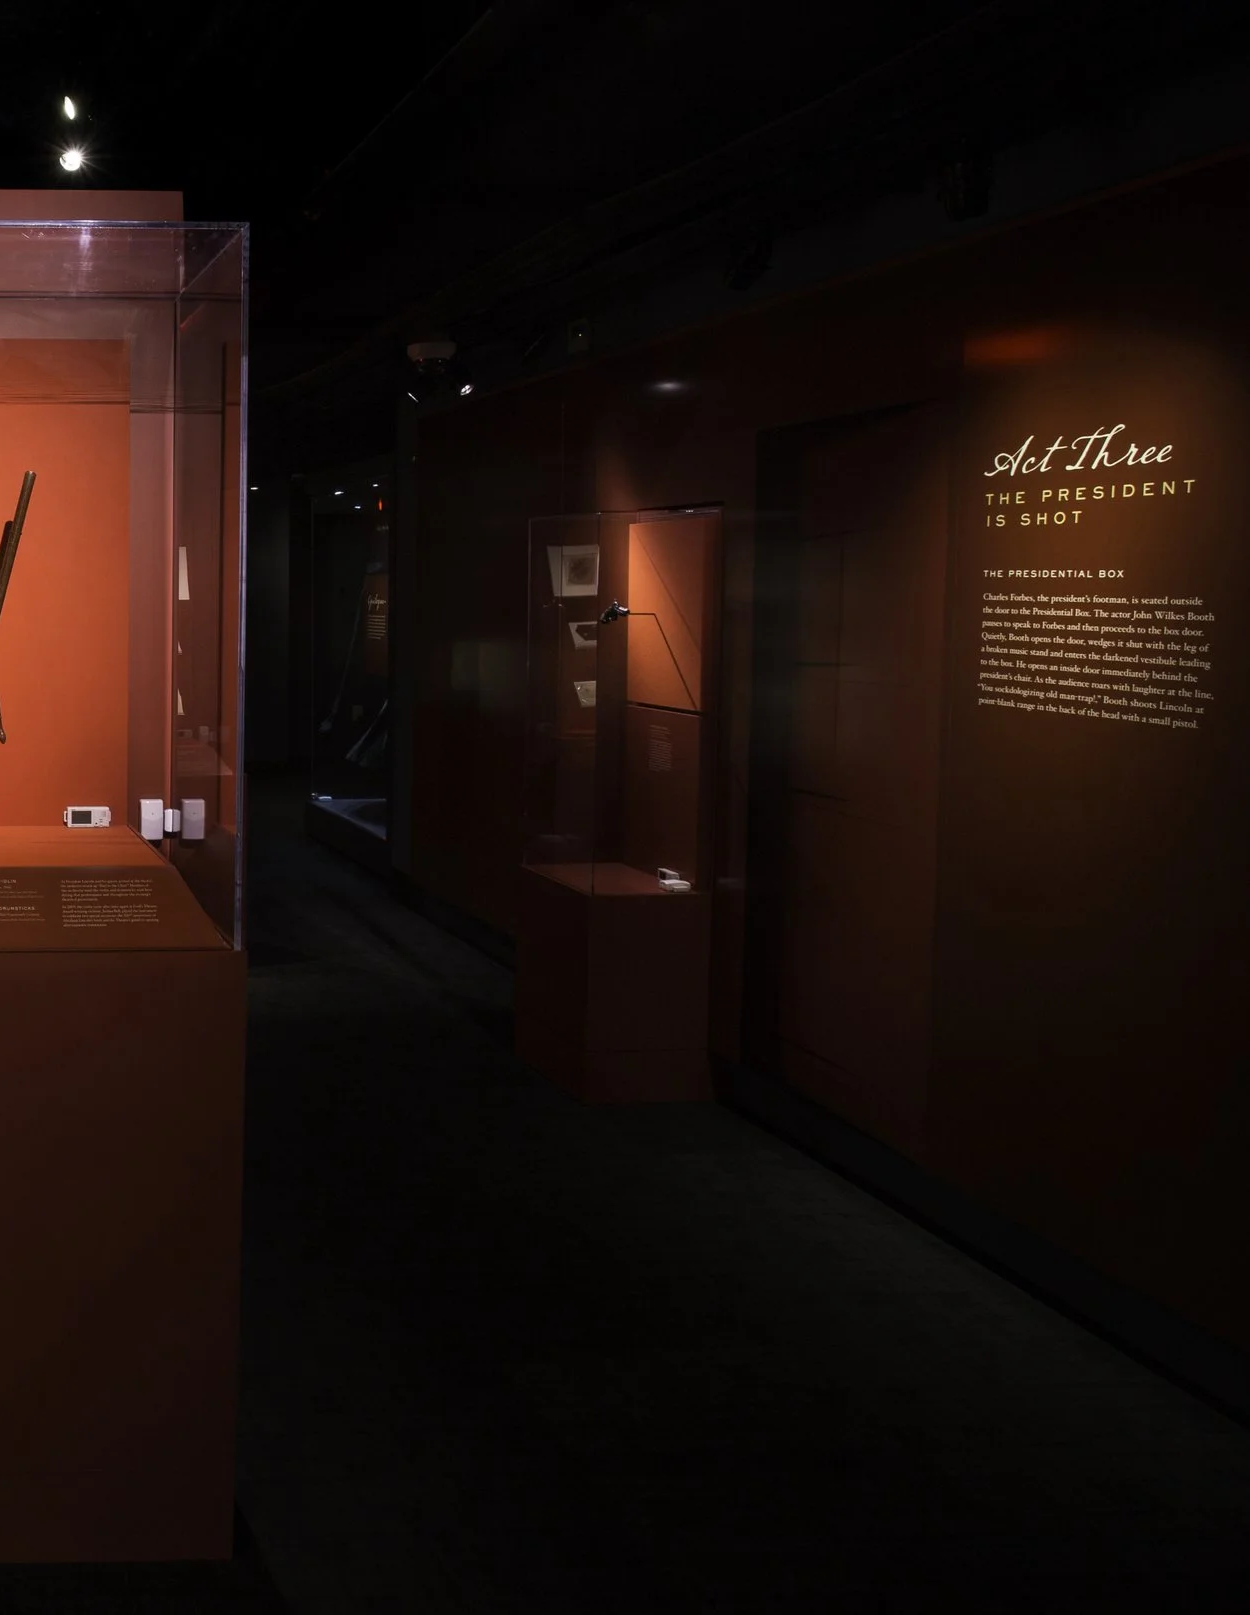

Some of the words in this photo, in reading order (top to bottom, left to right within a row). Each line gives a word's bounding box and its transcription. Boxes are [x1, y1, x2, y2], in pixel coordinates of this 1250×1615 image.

[984, 435, 1068, 477] Act
[1064, 423, 1173, 471] Three
[986, 491, 1026, 506] THE
[1042, 480, 1196, 502] PRESIDENT
[986, 514, 1006, 528] IS
[1020, 510, 1083, 526] SHOT
[983, 570, 1004, 578] THE
[1008, 570, 1093, 578] PRESIDENTIAL
[1099, 570, 1124, 578] BOX
[983, 592, 1008, 601] Charles
[1010, 594, 1036, 602] Forbes,
[1092, 595, 1130, 604] footman,
[1132, 596, 1138, 604] is
[1141, 596, 1168, 605] seated
[1170, 596, 1203, 606] outside
[1032, 608, 1073, 616] Presidential
[1094, 609, 1109, 618] The
[1131, 610, 1152, 620] John
[1154, 611, 1184, 620] Wilkes
[1188, 612, 1215, 621] Booth
[1012, 621, 1031, 629] speak
[1042, 622, 1065, 630] Forbes
[1101, 625, 1135, 634] proceeds
[1148, 626, 1162, 635] the
[1164, 626, 1180, 635] box
[1182, 627, 1204, 636] door.
[982, 632, 1007, 643] Quietly,
[1008, 633, 1029, 642] Booth
[1030, 636, 1051, 644] opens
[1066, 636, 1086, 646] door,
[1088, 639, 1115, 649] wedges
[1126, 640, 1142, 648] shut
[1145, 641, 1164, 650] with
[1167, 642, 1181, 650] the
[1184, 642, 1196, 653] leg
[1199, 643, 1210, 652] of
[986, 645, 1008, 653] broken
[1088, 652, 1100, 660] the
[1102, 652, 1138, 663] darkened
[1140, 656, 1177, 666] vestibule
[1179, 659, 1211, 670] leading
[1000, 659, 1014, 667] box.
[1016, 660, 1026, 668] He
[1028, 663, 1048, 671] opens
[1060, 664, 1081, 673] inside
[1082, 666, 1100, 674] door
[1102, 667, 1150, 680] immediately
[1152, 671, 1181, 681] behind
[1184, 674, 1198, 683] the
[1014, 674, 1032, 682] chair.
[1058, 678, 1090, 688] audience
[1112, 683, 1130, 692] with
[1132, 684, 1165, 695] laughter
[1178, 688, 1192, 697] the
[1195, 690, 1214, 700] line,
[978, 698, 1015, 707] point-blank
[1017, 702, 1035, 711] range
[1046, 703, 1057, 712] the
[1059, 705, 1075, 714] back
[1078, 707, 1087, 716] of
[1088, 709, 1100, 717] the
[1102, 709, 1120, 719] head
[1122, 712, 1139, 722] with
[1148, 716, 1170, 726] small
[1172, 719, 1198, 728] pistol.
[1046, 690, 1058, 698] old
[1103, 696, 1128, 706] Booth
[1130, 698, 1156, 709] shoots
[1159, 701, 1192, 713] Lincoln
